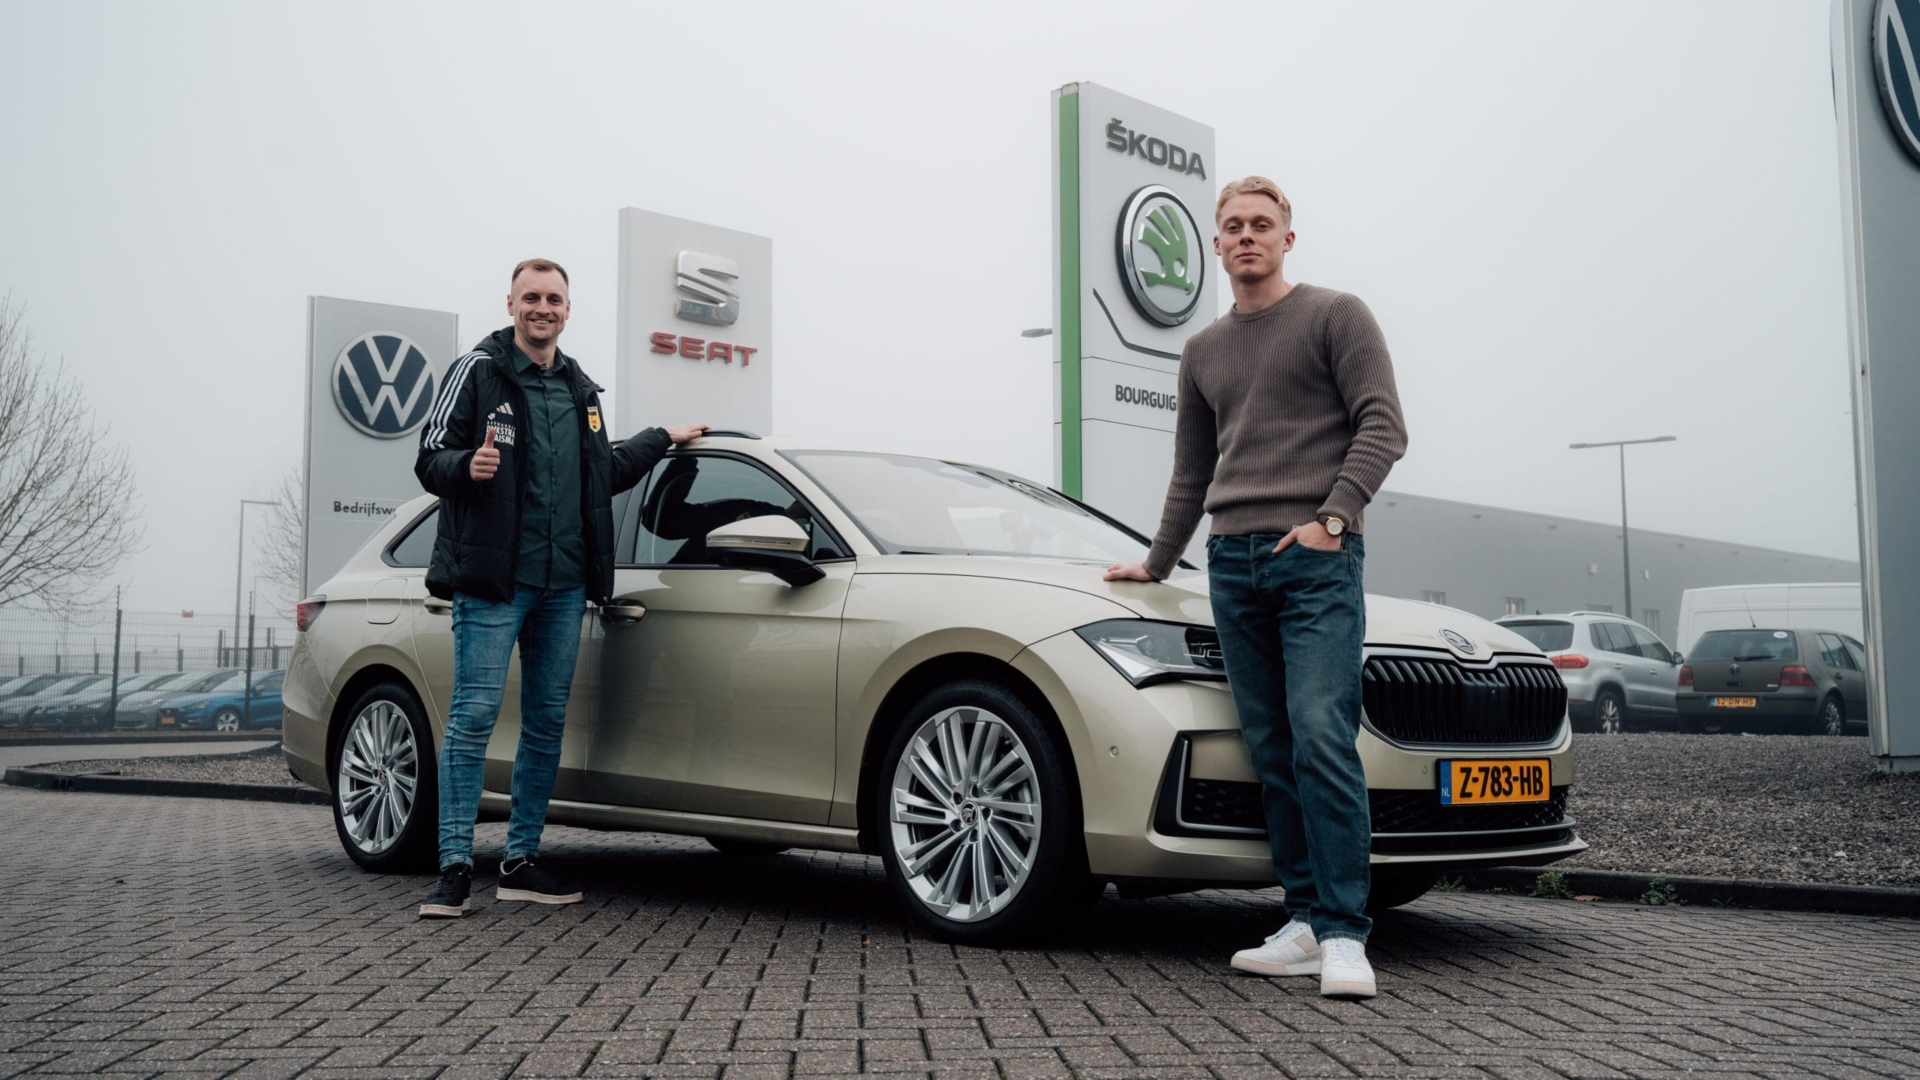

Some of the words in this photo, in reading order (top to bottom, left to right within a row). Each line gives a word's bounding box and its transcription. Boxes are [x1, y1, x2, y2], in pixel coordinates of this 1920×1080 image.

[1106, 117, 1207, 181] ŠKODA
[650, 331, 758, 367] SEAT
[1441, 787, 1450, 797] NL
[1459, 765, 1544, 798] Z-783-HB
